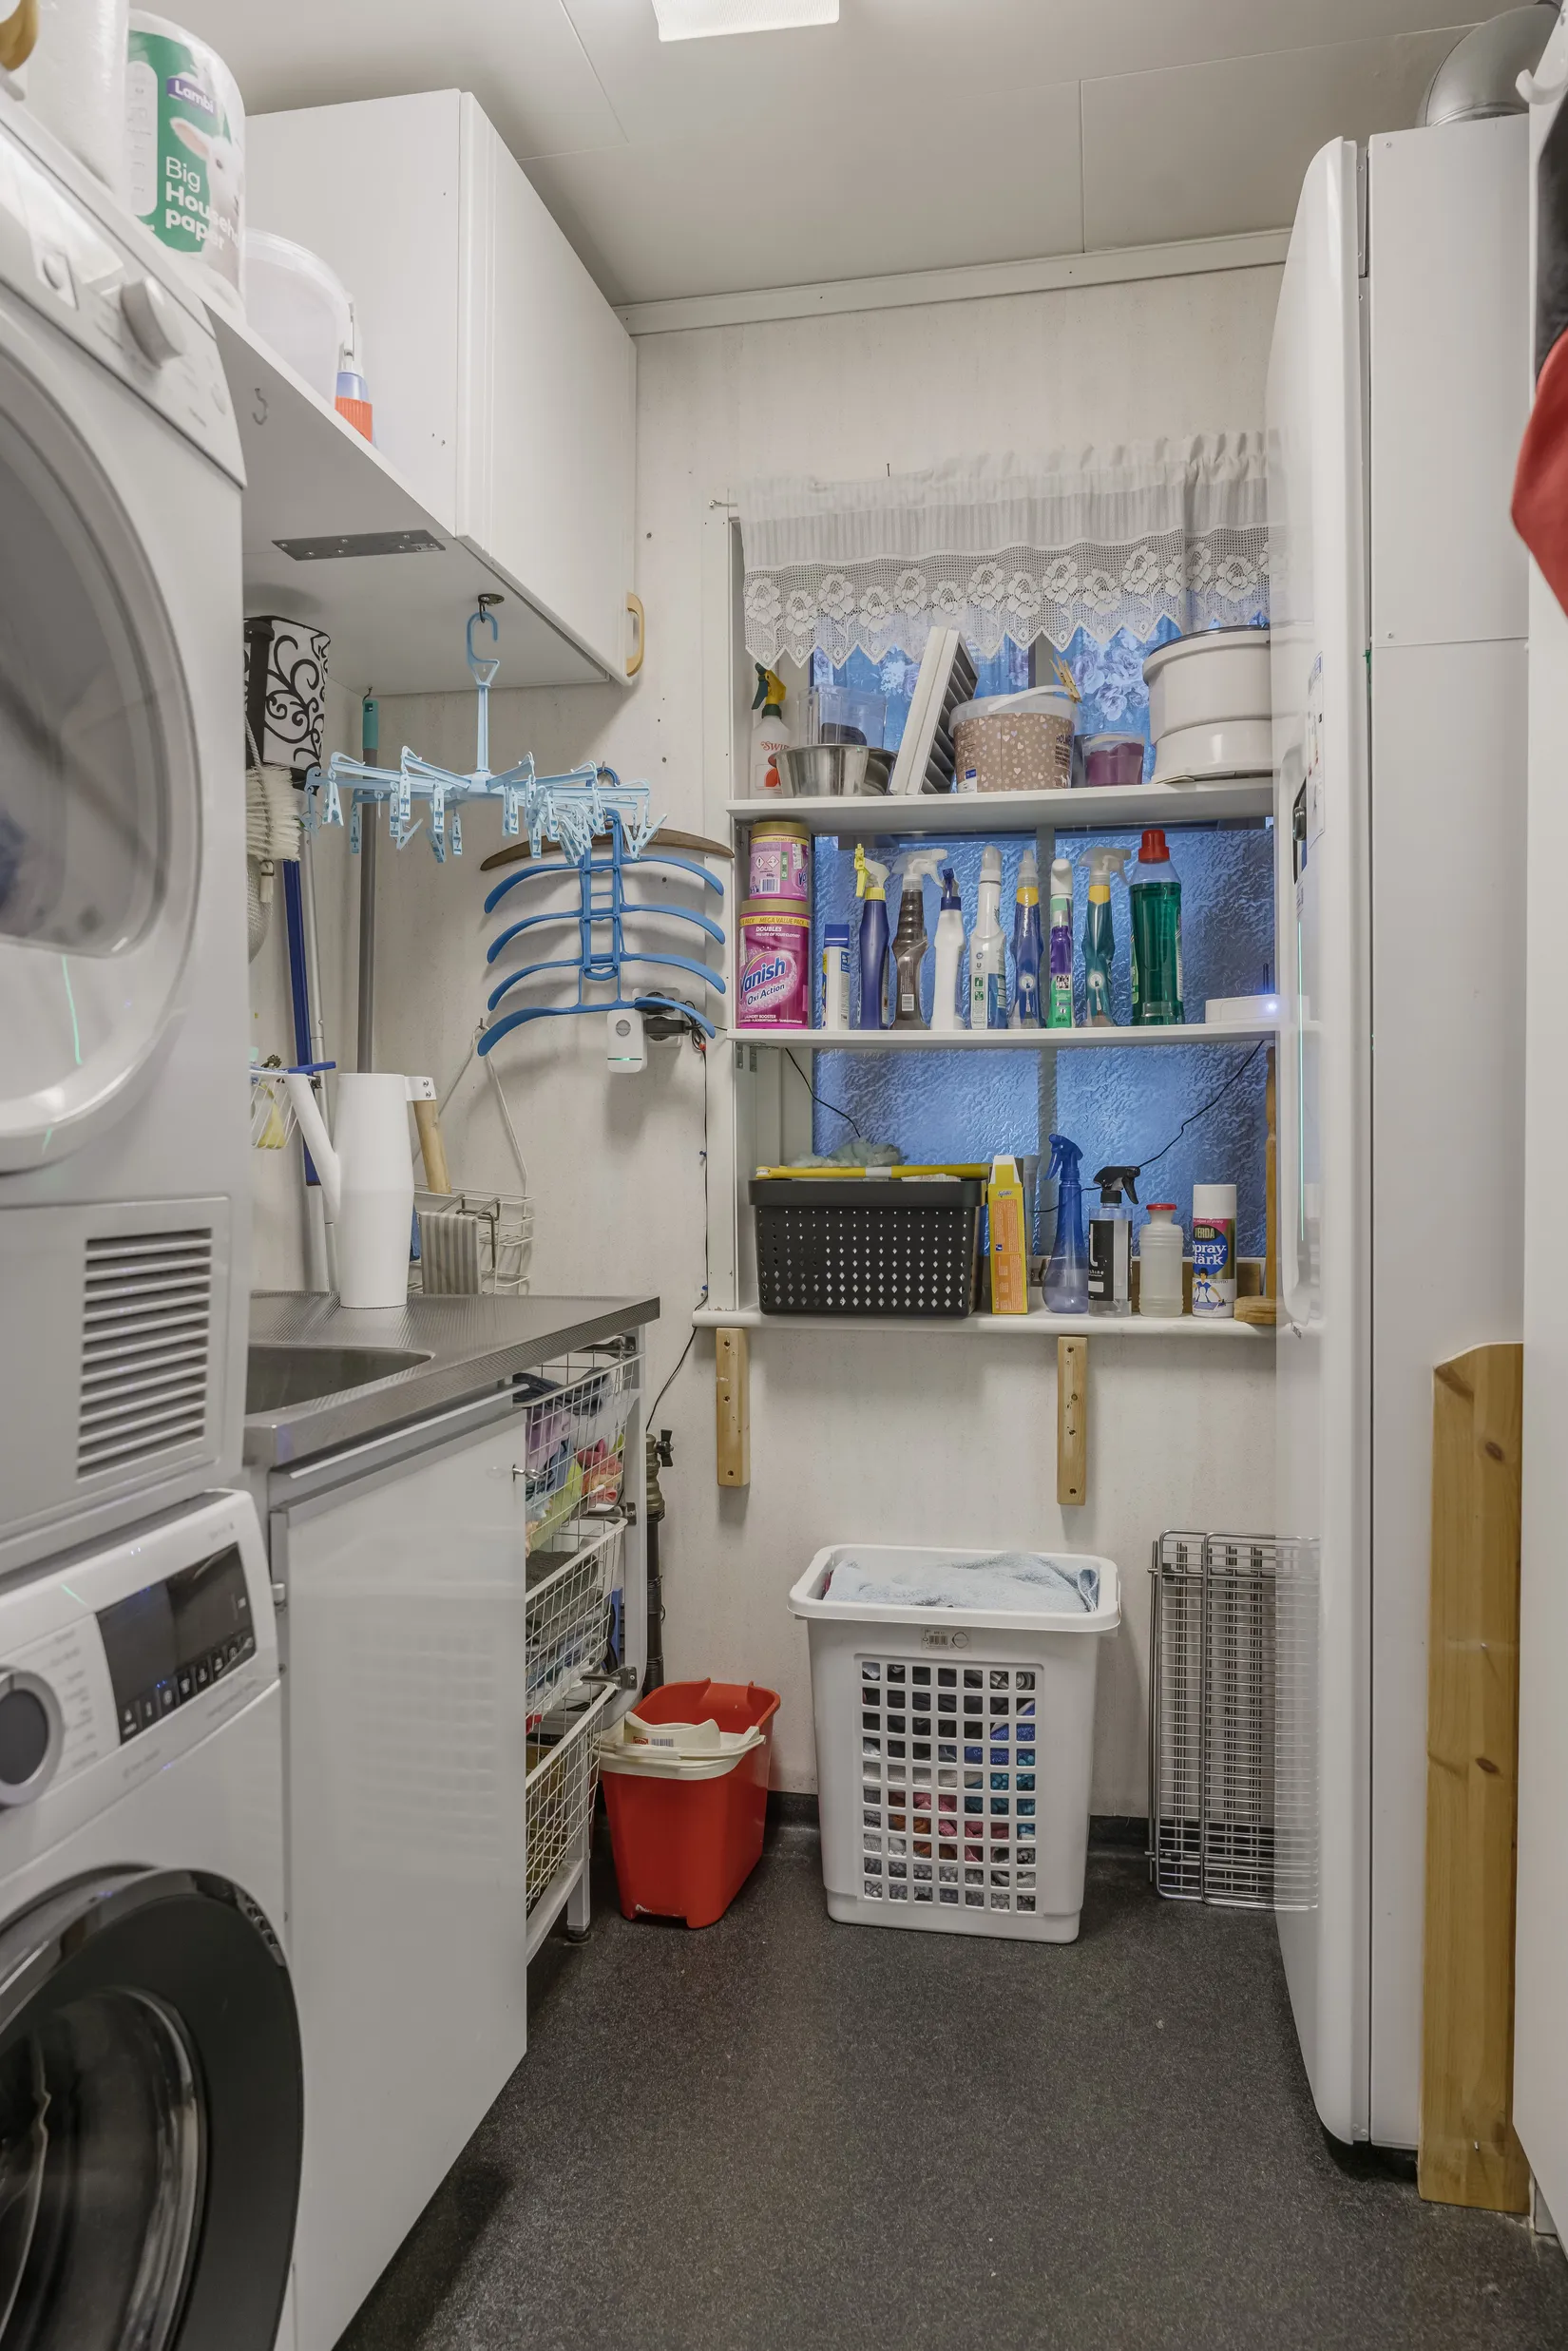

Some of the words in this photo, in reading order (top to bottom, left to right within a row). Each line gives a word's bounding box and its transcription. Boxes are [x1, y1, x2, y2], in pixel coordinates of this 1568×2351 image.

[174, 80, 214, 114] Lambi
[165, 156, 201, 193] Big
[165, 208, 225, 250] paper
[748, 993, 759, 1005] Oxi
[760, 984, 785, 999] Action
[1195, 1227, 1215, 1239] VERDA
[1193, 1253, 1224, 1265] tärk
